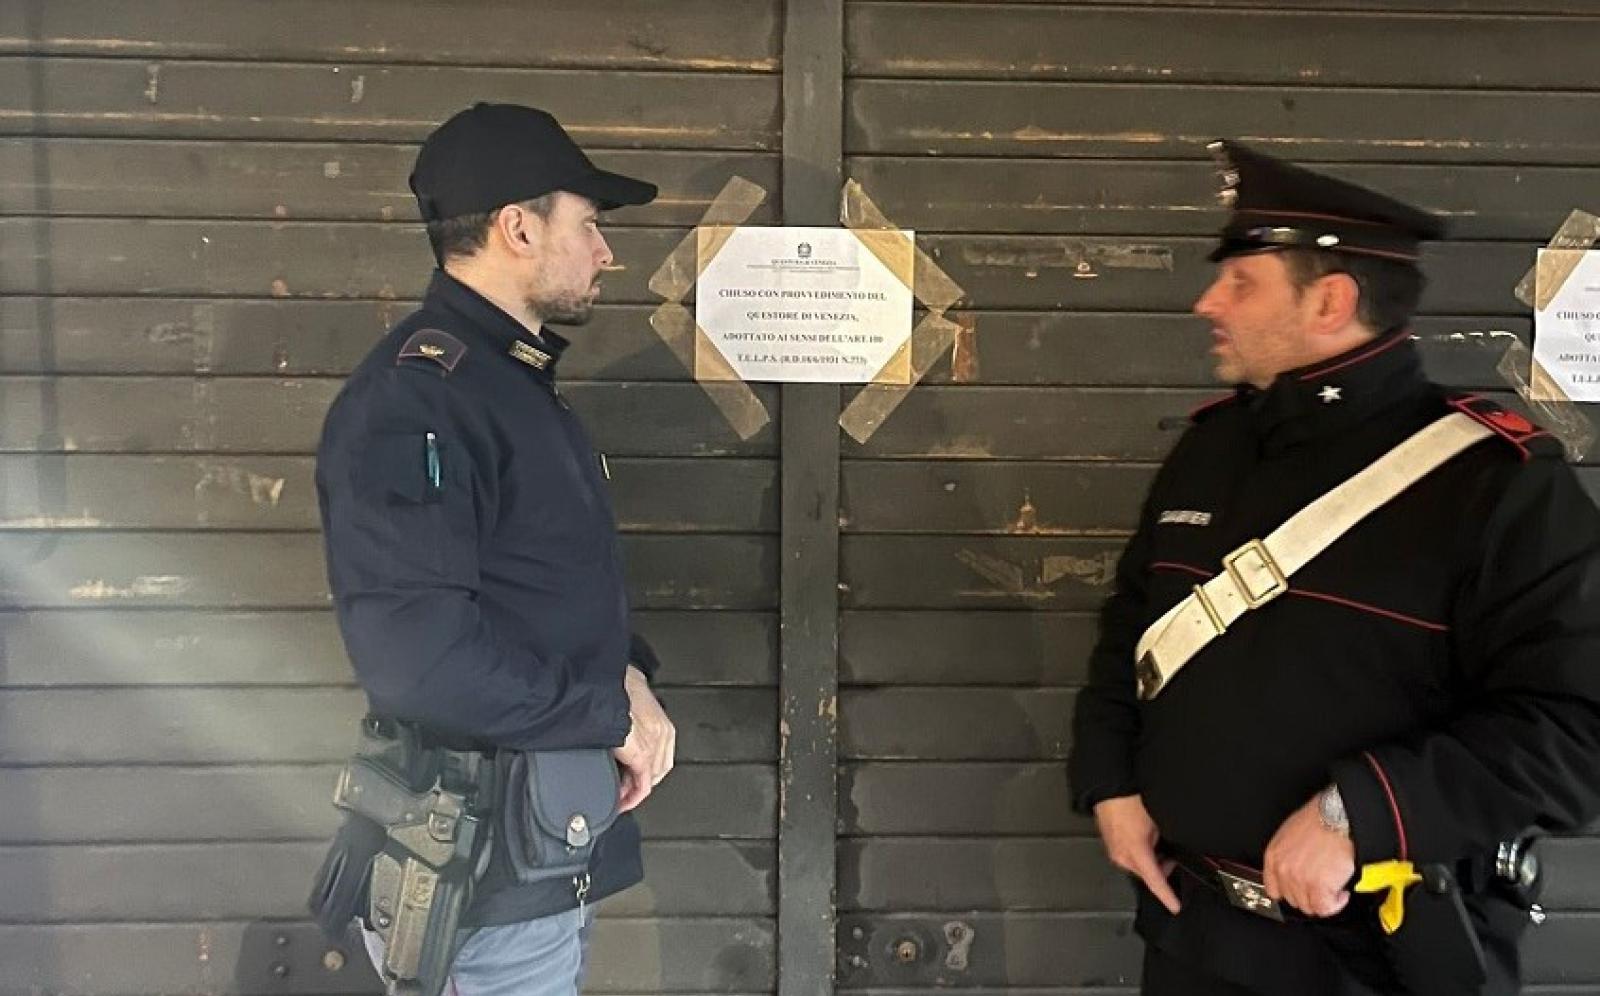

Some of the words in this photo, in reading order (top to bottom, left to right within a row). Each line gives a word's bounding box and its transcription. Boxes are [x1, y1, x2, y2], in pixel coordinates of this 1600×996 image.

[719, 288, 757, 298] CHIUSO
[758, 289, 779, 298] CON
[780, 289, 867, 300] PROVVEDIMENTO
[868, 291, 888, 300] DEL
[746, 310, 799, 320] QUESTORE
[801, 311, 812, 320] DI
[1556, 310, 1595, 321] CHIUSO
[723, 332, 775, 341] ADOTTATO
[777, 333, 788, 342] AI
[789, 334, 818, 342] SENSI
